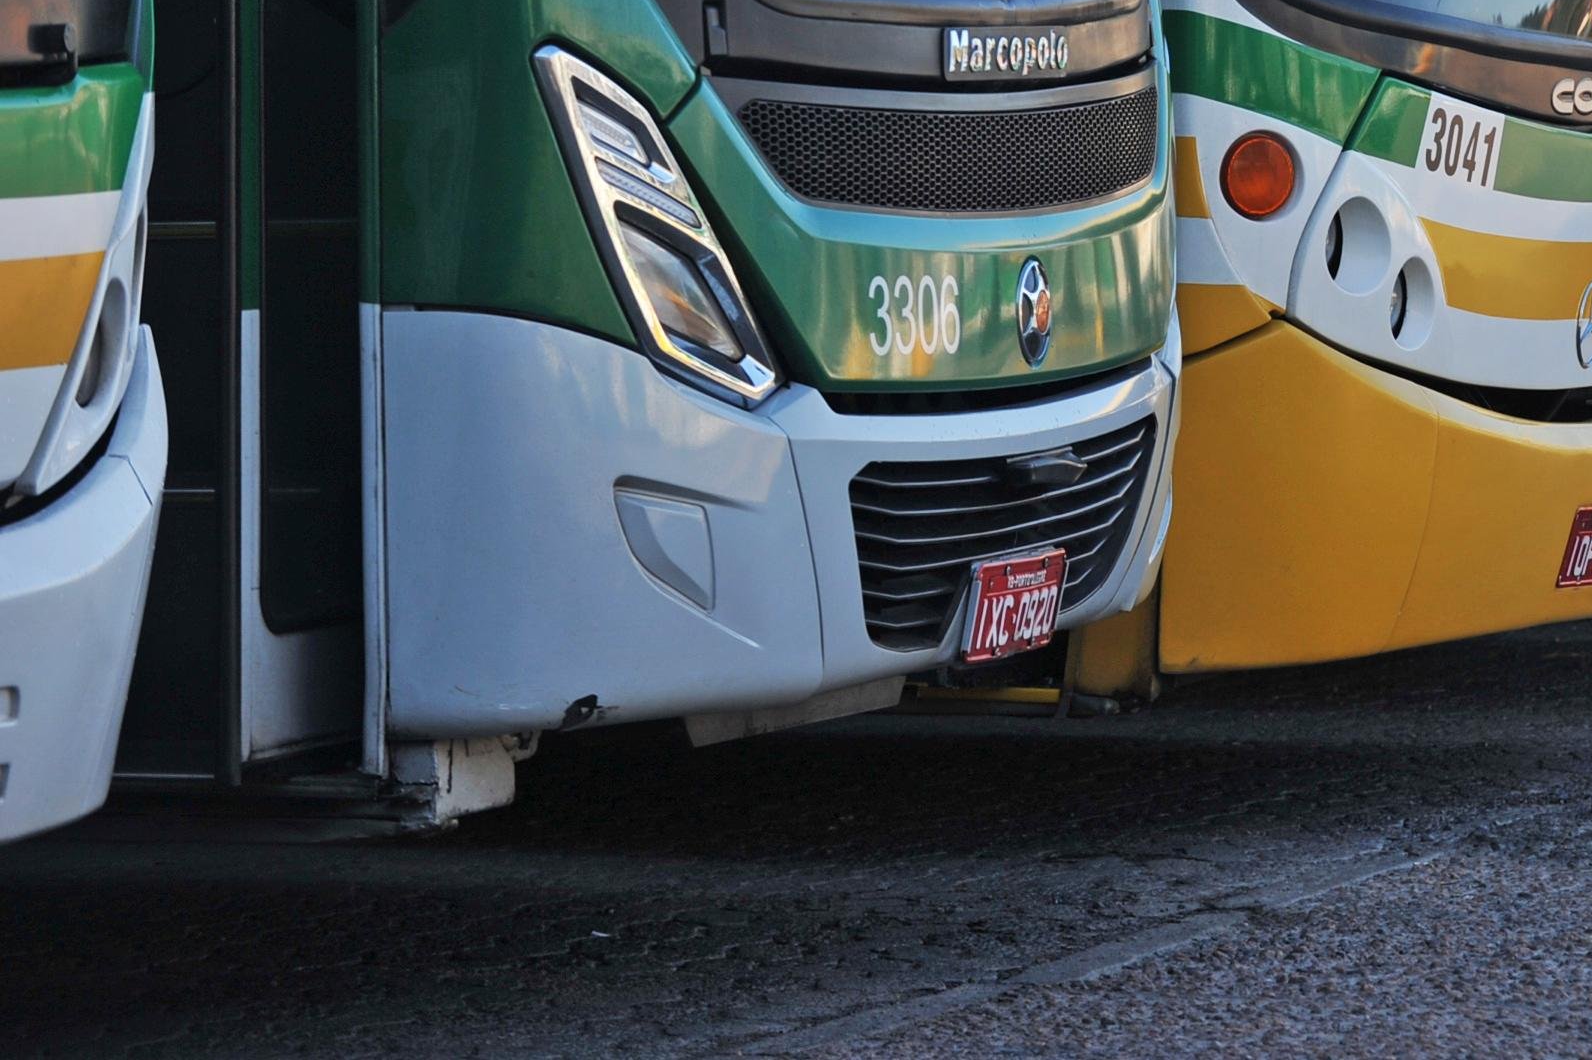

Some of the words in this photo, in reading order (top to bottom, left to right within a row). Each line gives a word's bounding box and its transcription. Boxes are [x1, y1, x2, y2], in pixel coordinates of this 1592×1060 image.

[949, 27, 1068, 76] Marcopolo
[1426, 107, 1497, 187] 3041
[868, 275, 961, 356] 3306
